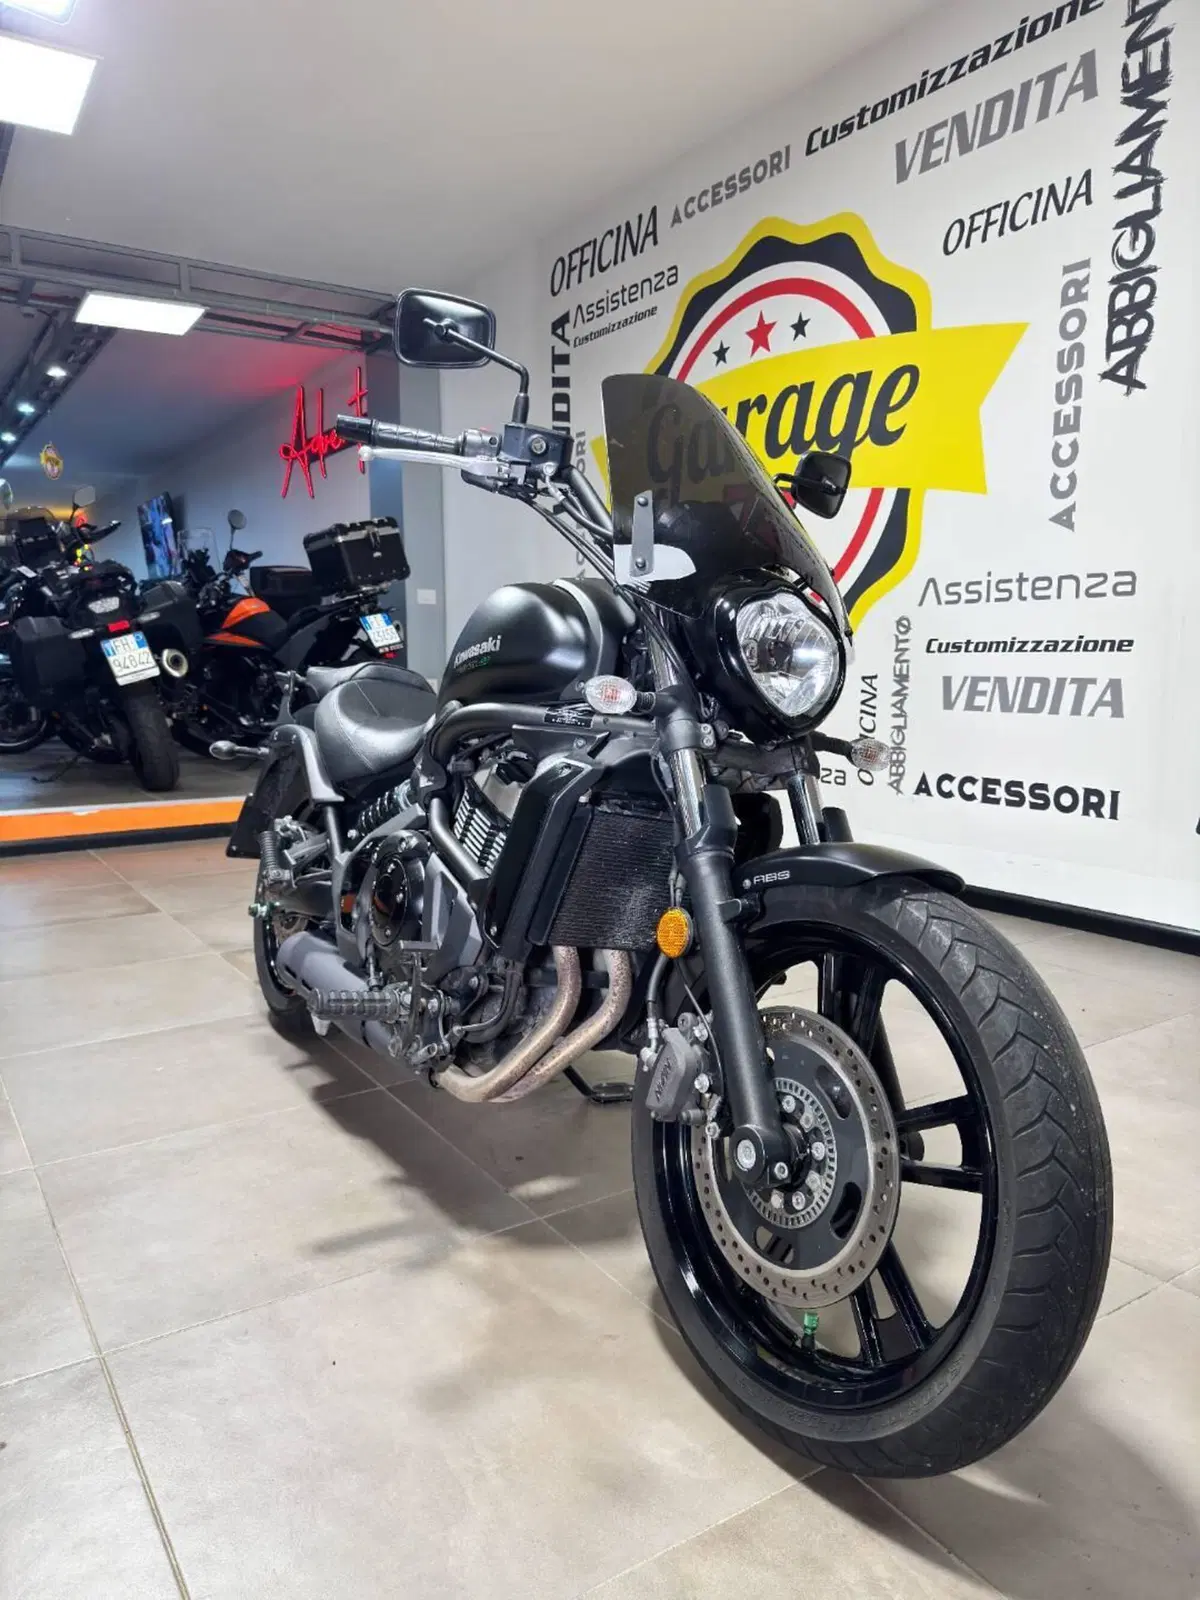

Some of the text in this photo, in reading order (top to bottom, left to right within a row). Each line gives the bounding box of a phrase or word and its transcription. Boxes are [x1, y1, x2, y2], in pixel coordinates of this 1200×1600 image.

[805, 0, 1105, 157] Customizzazione
[895, 48, 1099, 185] VENDITA
[670, 144, 791, 228] ACCESSORI
[942, 168, 1093, 256] OFFICINA
[551, 205, 658, 297] OFFICINA
[573, 264, 679, 328] Assistenza
[573, 306, 658, 348] Customizzazione
[647, 362, 920, 508] Garage
[1048, 257, 1091, 532] ACCESSORI
[918, 570, 1137, 607] Assistenza
[925, 635, 1135, 654] Customizzazione
[857, 673, 879, 787] OICINA
[887, 615, 912, 796] ABBIGLIAMENTO
[941, 675, 1125, 719] VENDITA
[913, 771, 1121, 821] ACCESSORI
[753, 870, 790, 885] ABS
